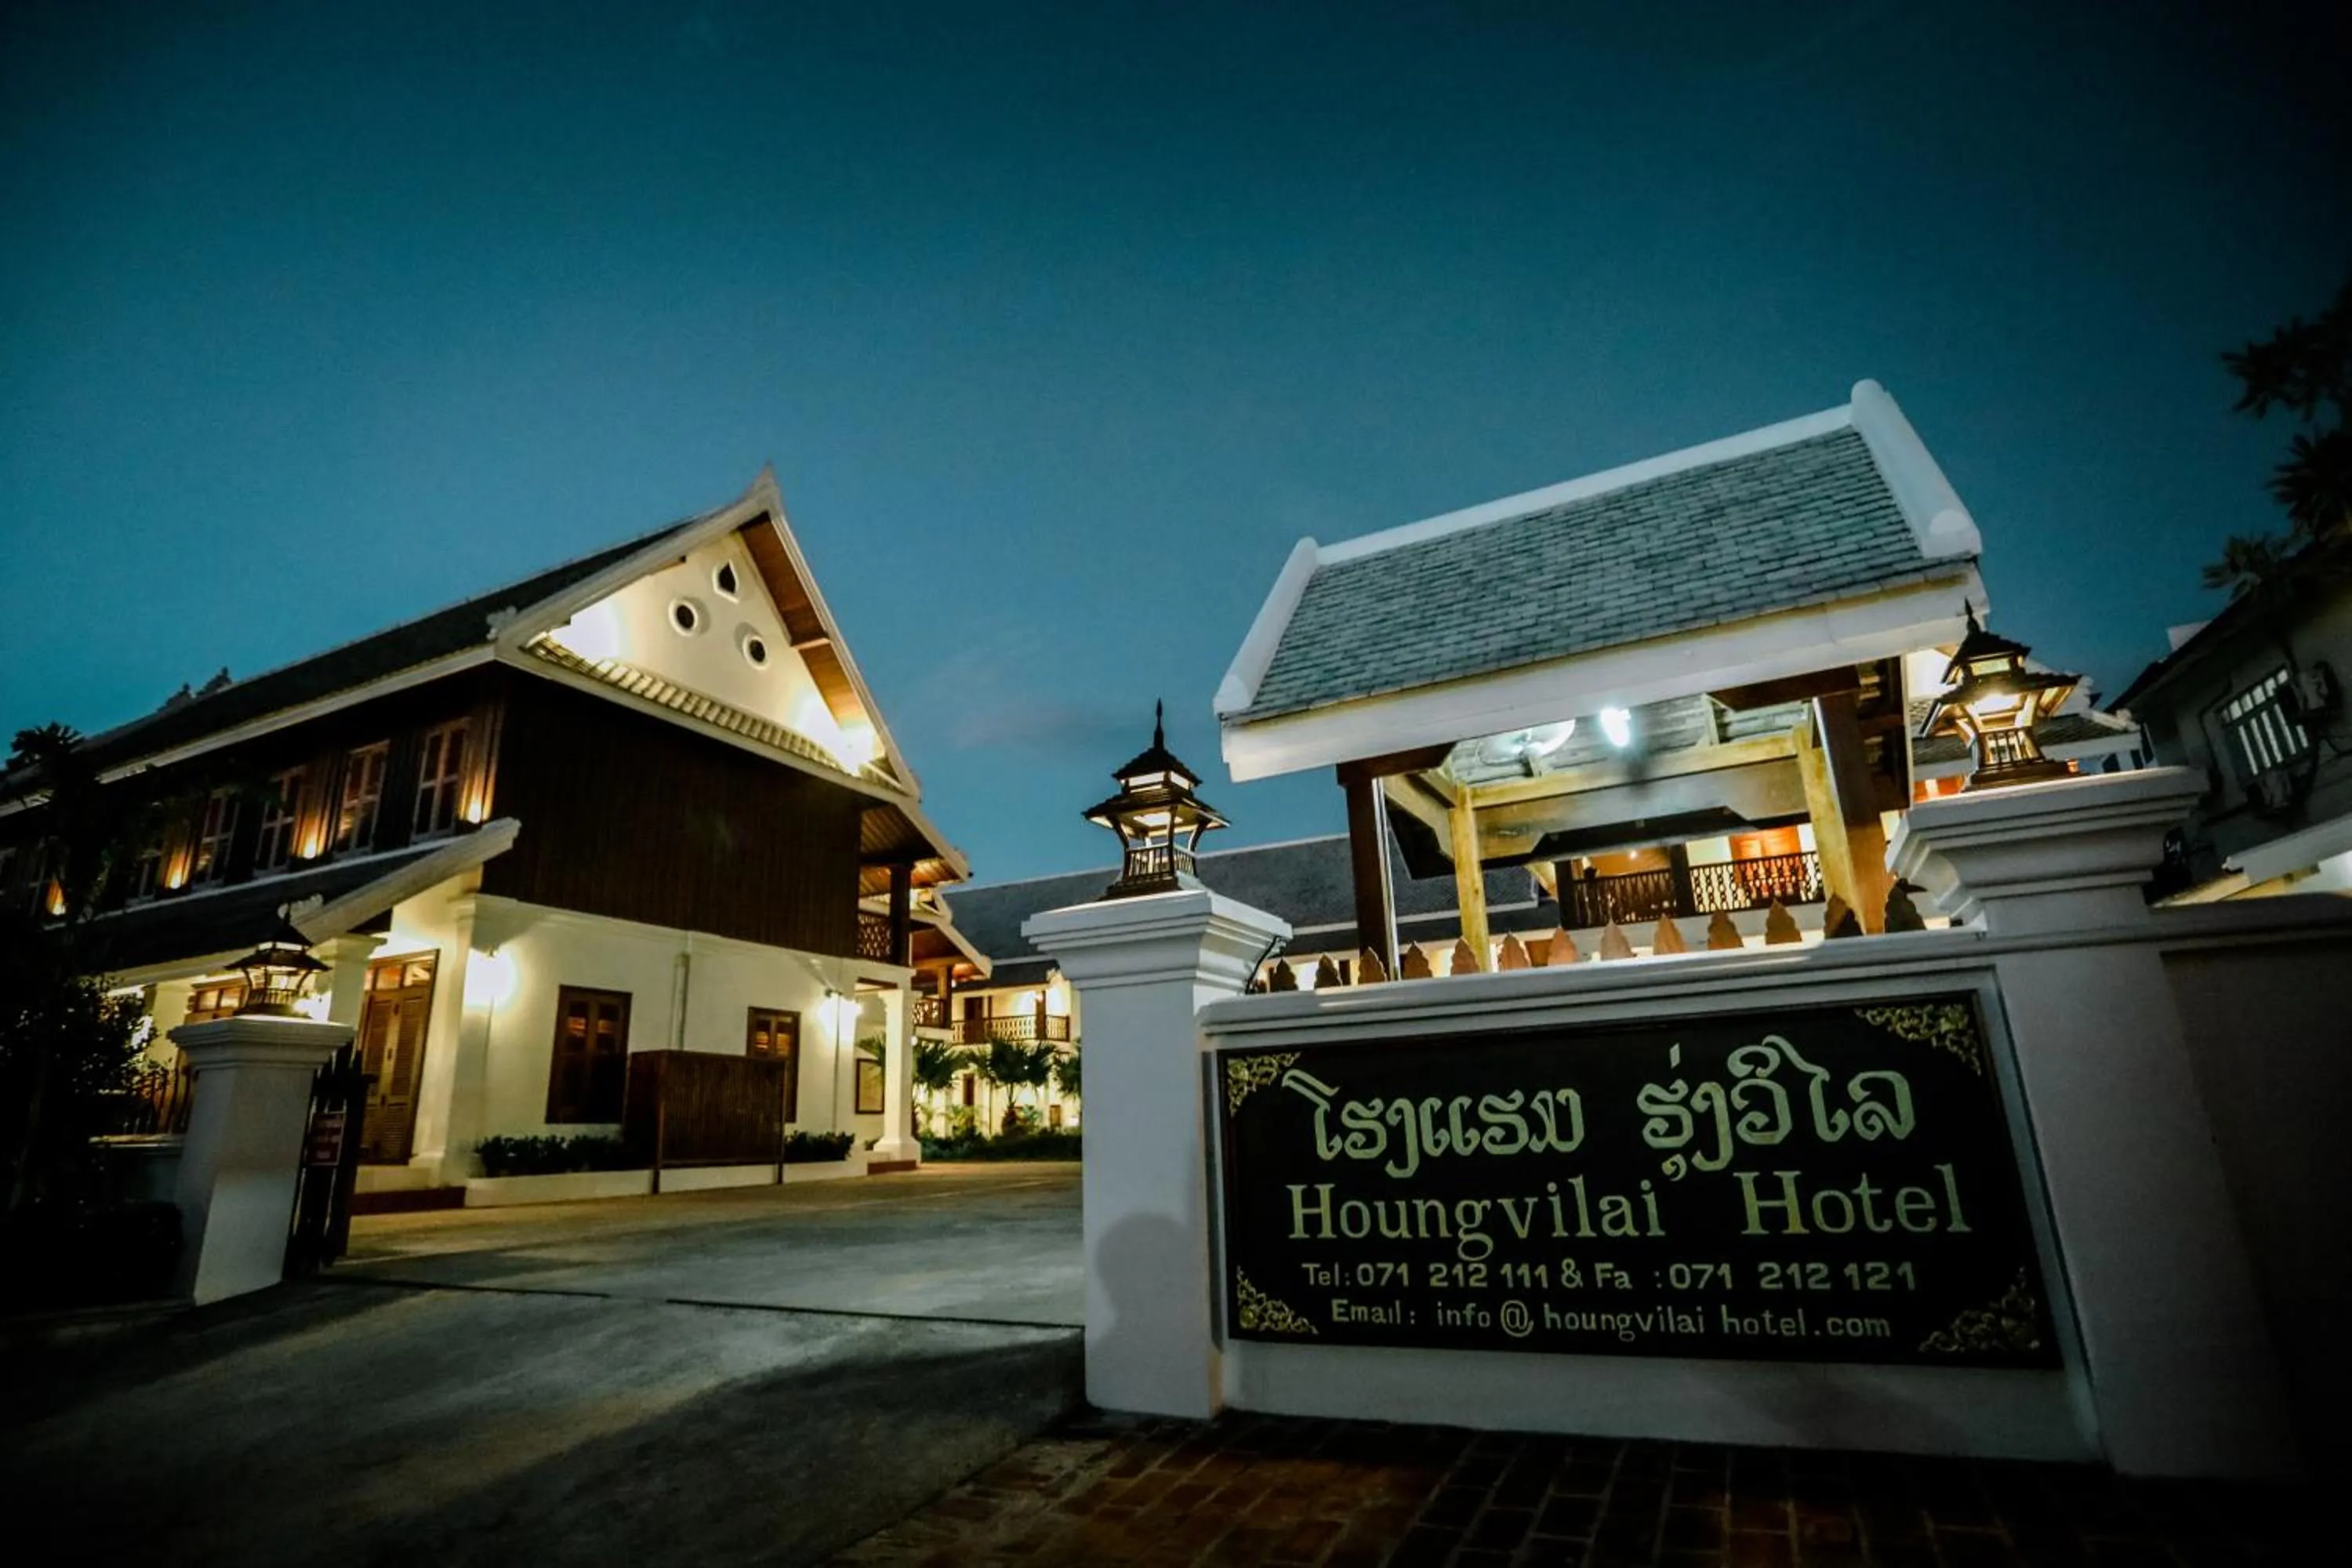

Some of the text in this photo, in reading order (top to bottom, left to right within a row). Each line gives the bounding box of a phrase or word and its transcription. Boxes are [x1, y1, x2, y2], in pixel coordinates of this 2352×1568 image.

[1285, 1163, 1972, 1261] Houngvilai Hotel
[1428, 1261, 1488, 1288] 212
[1499, 1262, 1549, 1290] 111
[1560, 1257, 1584, 1290] &
[1594, 1261, 1633, 1290] Fa
[1757, 1261, 1832, 1290] 212
[1843, 1261, 1916, 1291] 121
[1542, 1301, 1705, 1342] houngvilai
[1720, 1303, 1892, 1338] hotel.com
